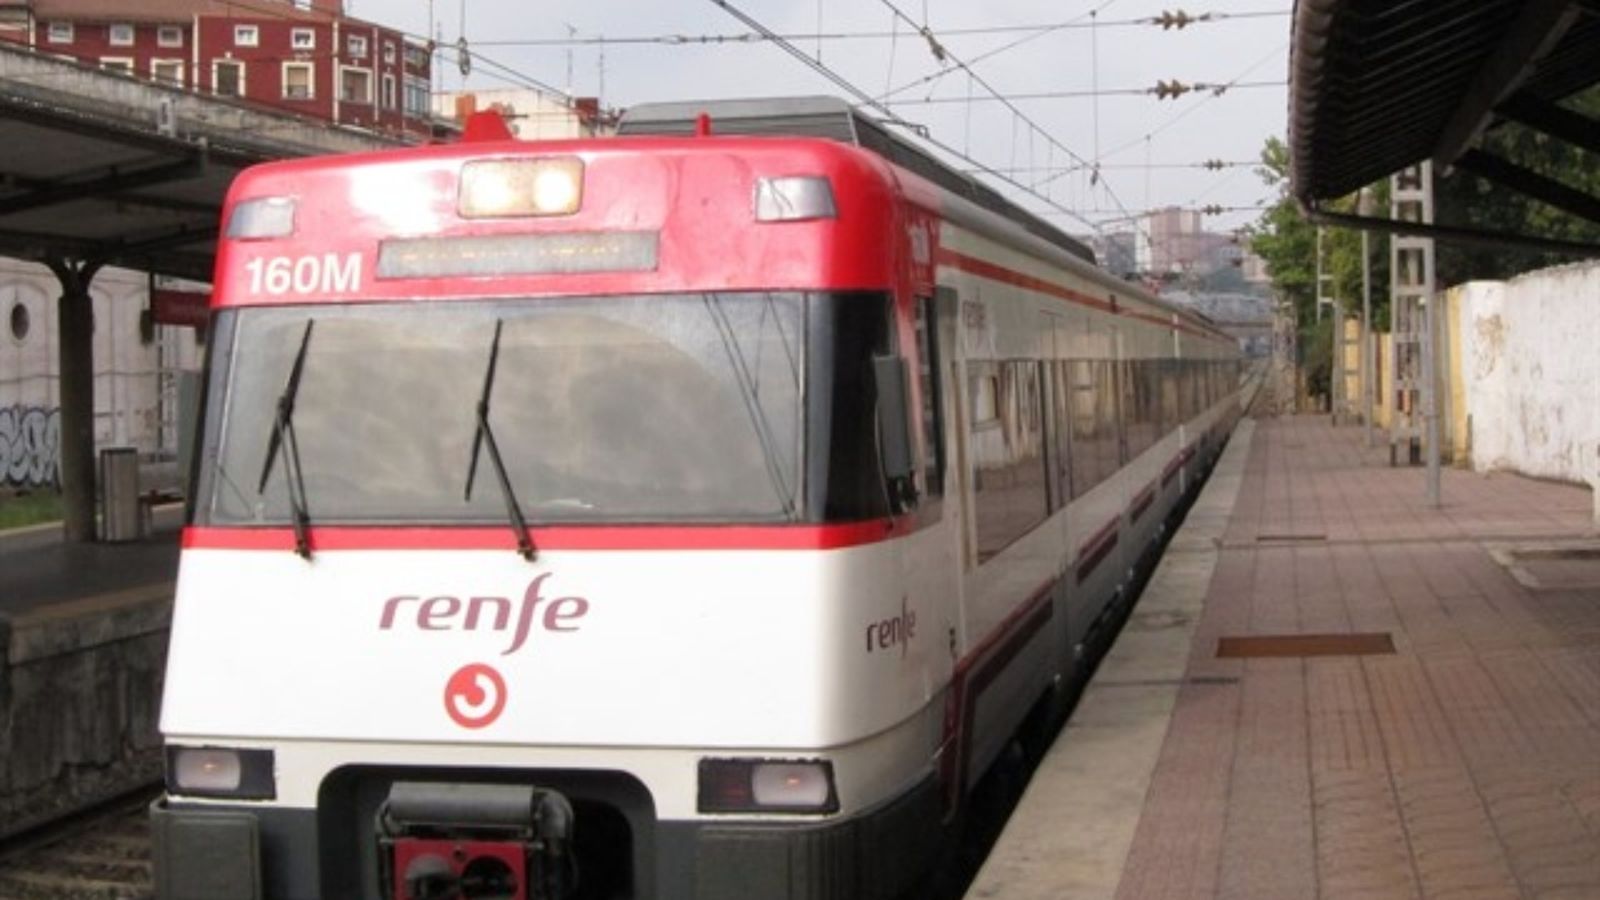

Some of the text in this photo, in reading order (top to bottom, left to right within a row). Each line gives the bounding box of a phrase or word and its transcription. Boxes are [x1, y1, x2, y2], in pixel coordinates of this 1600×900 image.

[246, 253, 362, 295] 160M
[378, 571, 590, 656] renfe
[866, 596, 916, 660] renfe
